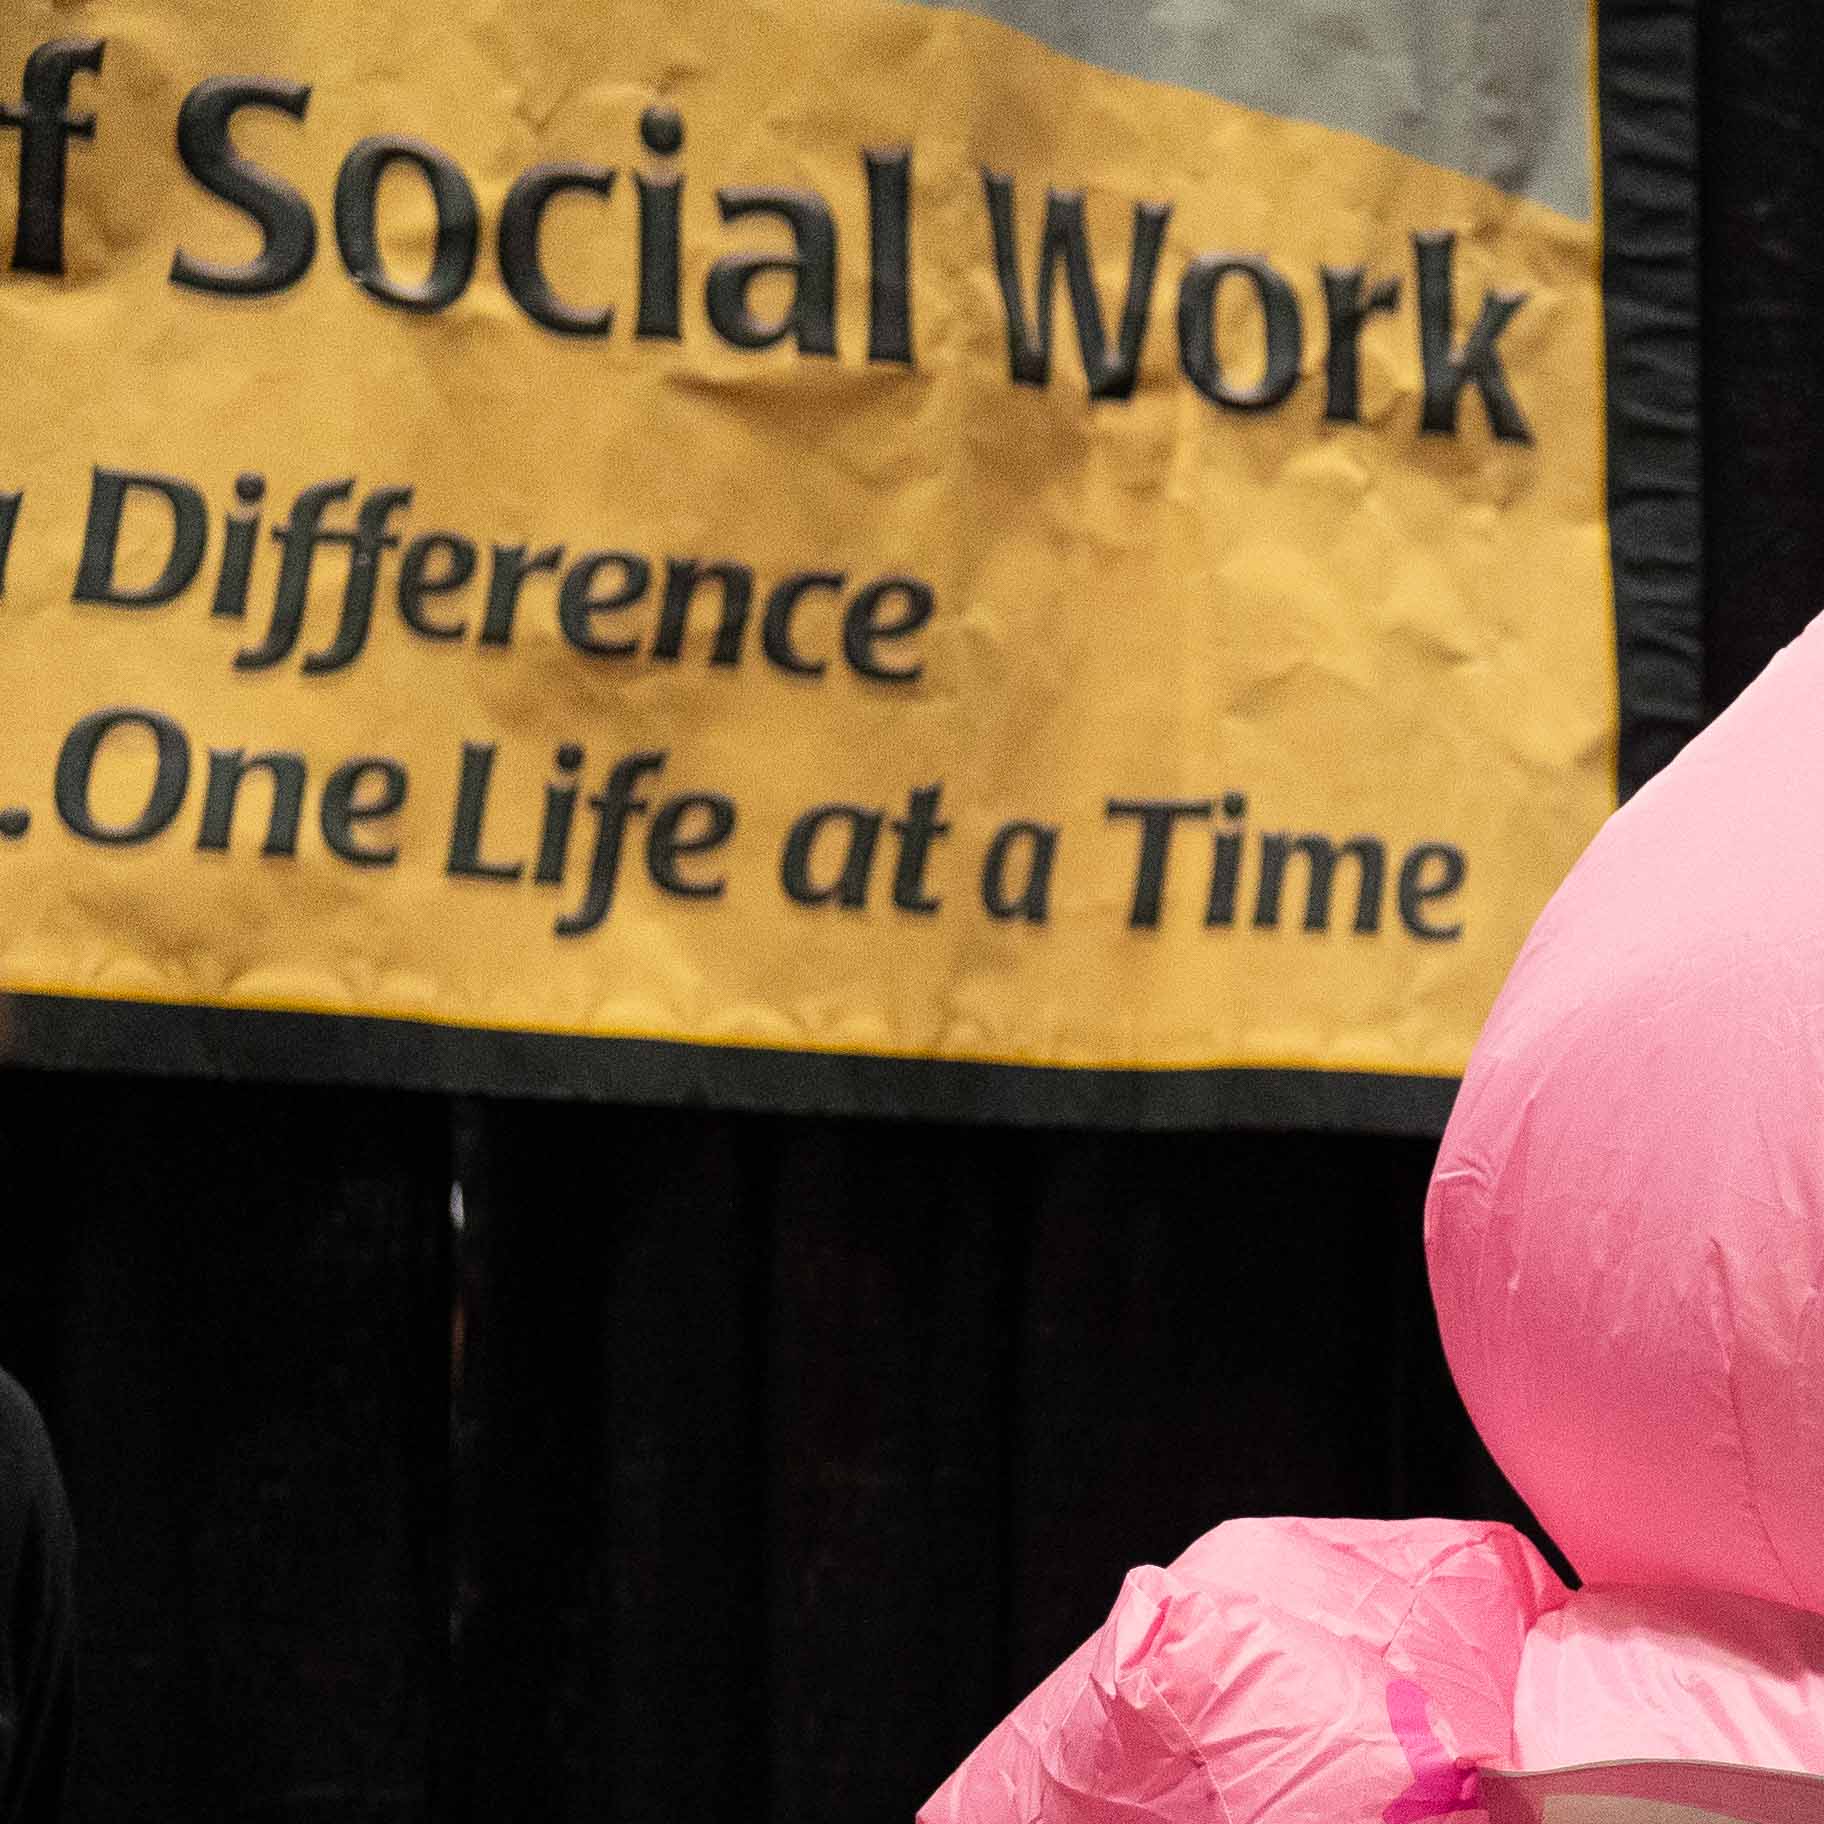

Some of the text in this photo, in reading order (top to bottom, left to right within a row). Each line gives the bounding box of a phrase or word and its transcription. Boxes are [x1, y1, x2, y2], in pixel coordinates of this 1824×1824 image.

[168, 74, 917, 368] Social
[983, 168, 1535, 445] Work
[70, 466, 937, 683] Difference
[443, 741, 733, 937] Life
[778, 787, 948, 915] at
[982, 814, 1059, 926] a
[1106, 792, 1466, 942] Time
